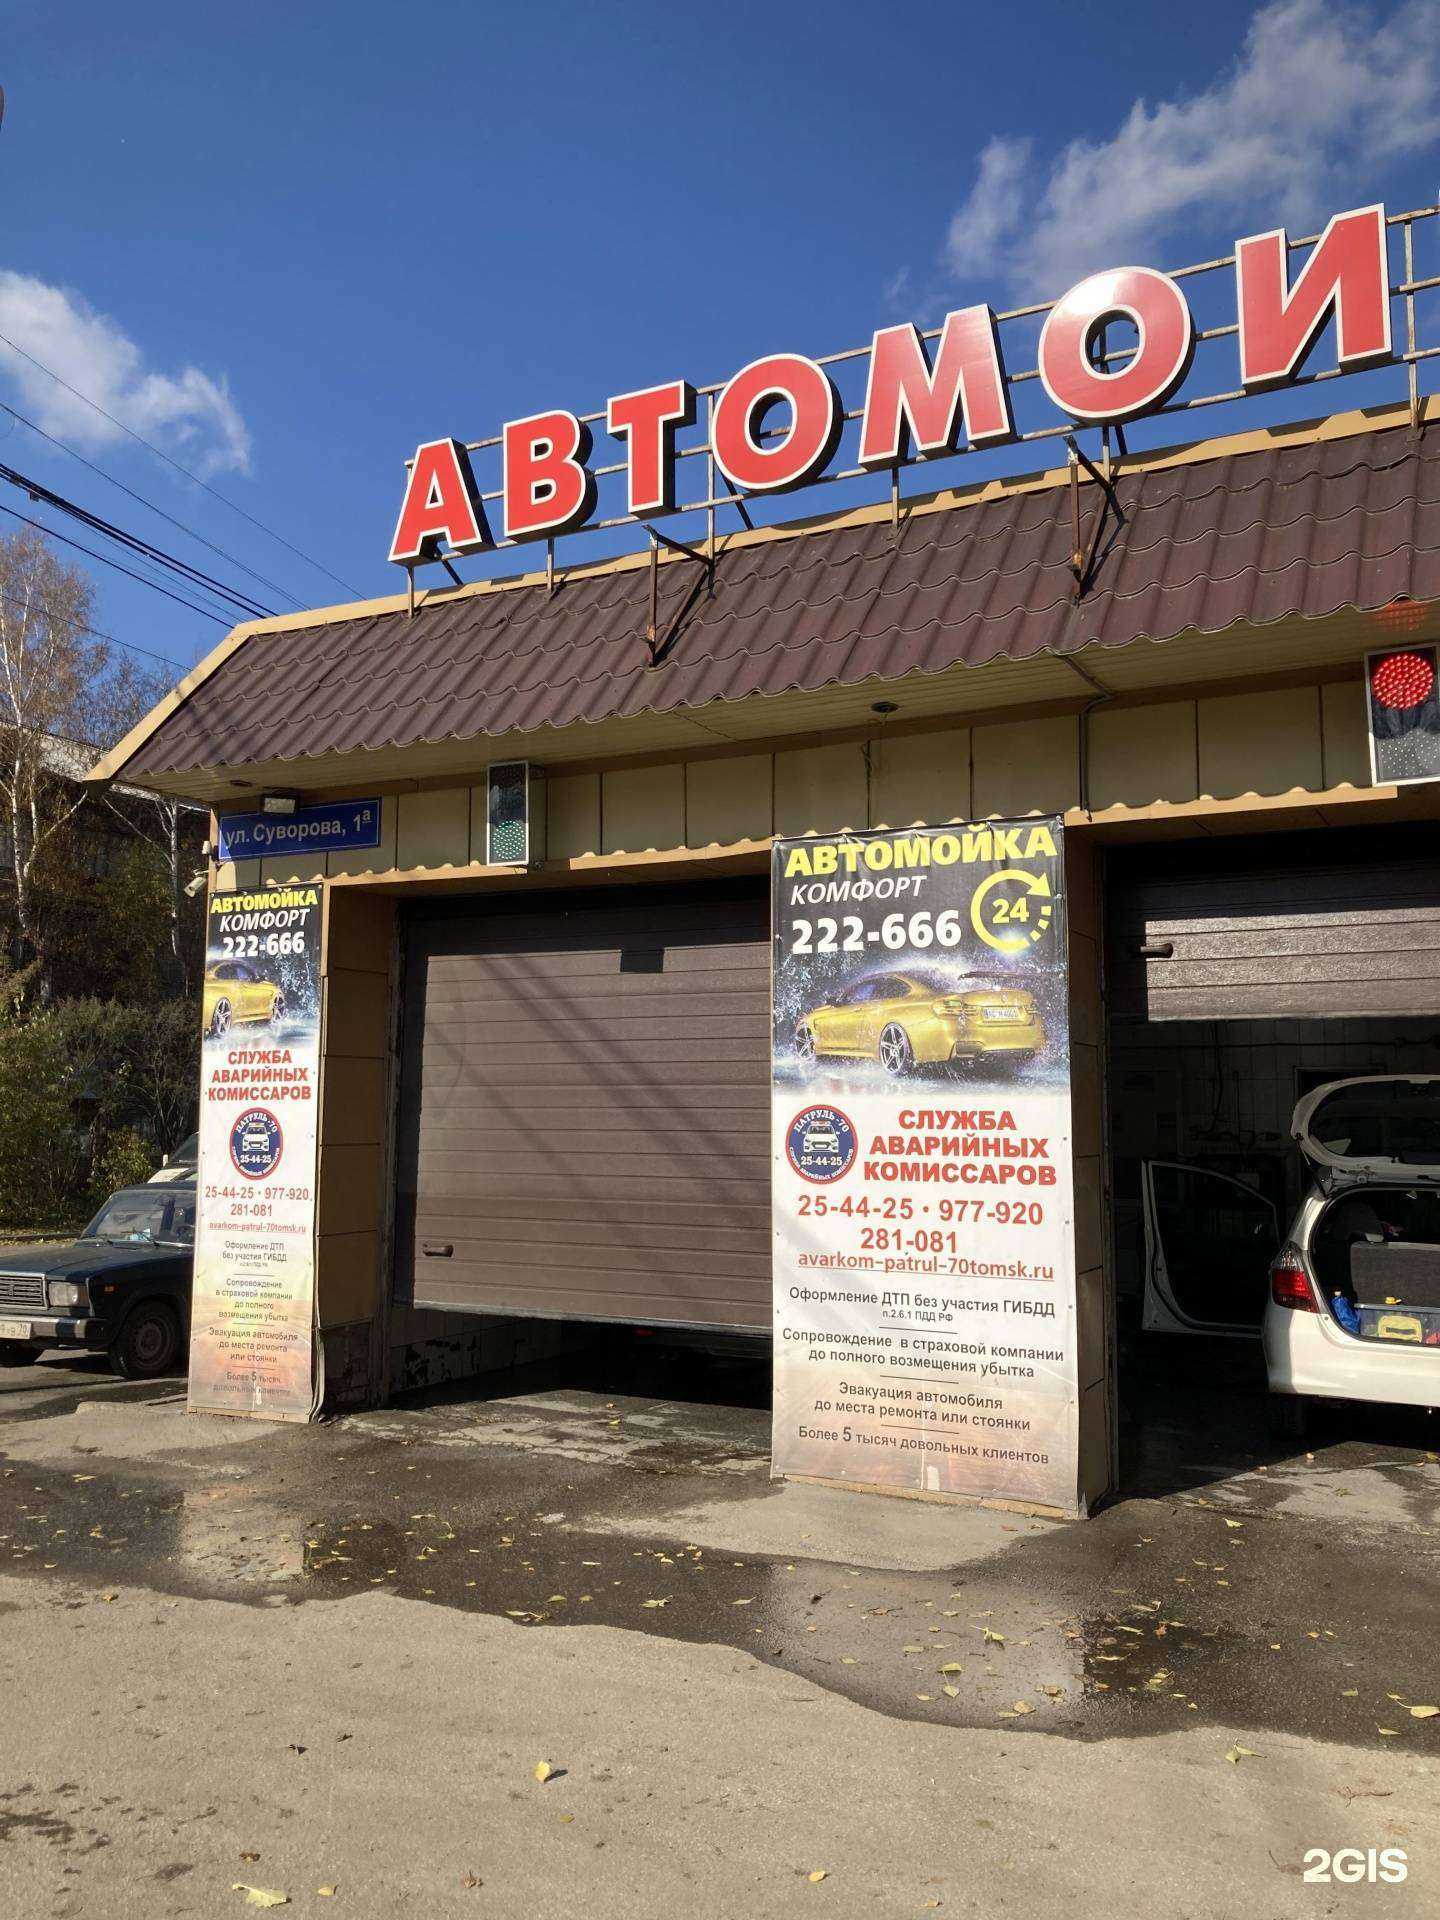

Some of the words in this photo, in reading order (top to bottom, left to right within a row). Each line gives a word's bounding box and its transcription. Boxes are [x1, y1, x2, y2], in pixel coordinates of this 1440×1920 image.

[226, 829, 250, 848] ул.
[253, 820, 346, 845] Суворова,
[784, 823, 1058, 878] АВТОМОЙКА
[210, 888, 318, 914] АВТОМОЙКА
[790, 875, 927, 905] КОМФОРТ
[219, 908, 311, 932] КОМФОРТ
[992, 897, 1030, 924] 24
[222, 931, 305, 958] 222-666
[792, 910, 962, 955] 222-666
[228, 1050, 292, 1065] СЛУЖБА
[211, 1066, 309, 1083] АВАРИЙНЫХ
[208, 1086, 312, 1101] КОМИССАРОВ
[898, 1109, 1017, 1131] СЛУЖБА
[240, 1154, 272, 1163] 25-44-25
[869, 1133, 1050, 1158] АВАРИЙНЫХ
[800, 1155, 843, 1166] 25-44-25
[863, 1161, 1057, 1186] КОМИССАРОВ
[205, 1186, 254, 1199] 25-44-25
[264, 1187, 309, 1201] 977-920
[230, 1203, 273, 1217] 281-081
[797, 1194, 914, 1220] 25-44-25
[939, 1199, 1044, 1225] 977-920
[860, 1227, 957, 1253] 281-081
[797, 1251, 1054, 1281] avarkom-patrul-70tomsk.ru
[226, 1278, 282, 1289] Сопровождение
[789, 1286, 878, 1304] Оформление
[881, 1292, 910, 1307] ДТП
[914, 1293, 938, 1308] без
[941, 1297, 998, 1312] участия
[1003, 1300, 1055, 1318] ГИБДД
[915, 1311, 936, 1322] ПДД
[938, 1312, 953, 1323] РФ
[782, 1328, 892, 1348] Сопровождение
[900, 1338, 908, 1348] в
[912, 1337, 986, 1356] страховой
[991, 1346, 1064, 1362] компании
[808, 1348, 826, 1361] до
[830, 1350, 885, 1365] полного
[889, 1356, 976, 1373] возмещения
[981, 1362, 1034, 1379] убытка
[839, 1381, 912, 1400] Эвакуация
[916, 1390, 1003, 1410] автомобиля
[814, 1399, 831, 1412] до
[835, 1402, 875, 1415] места
[879, 1406, 937, 1421] ремонта
[941, 1413, 967, 1425] или
[972, 1415, 1030, 1431] стоянки
[798, 1426, 839, 1441] Более
[843, 1426, 852, 1443] 5
[856, 1433, 896, 1447] тысяч
[900, 1437, 979, 1457] довольных
[982, 1448, 1049, 1464] клиентов
